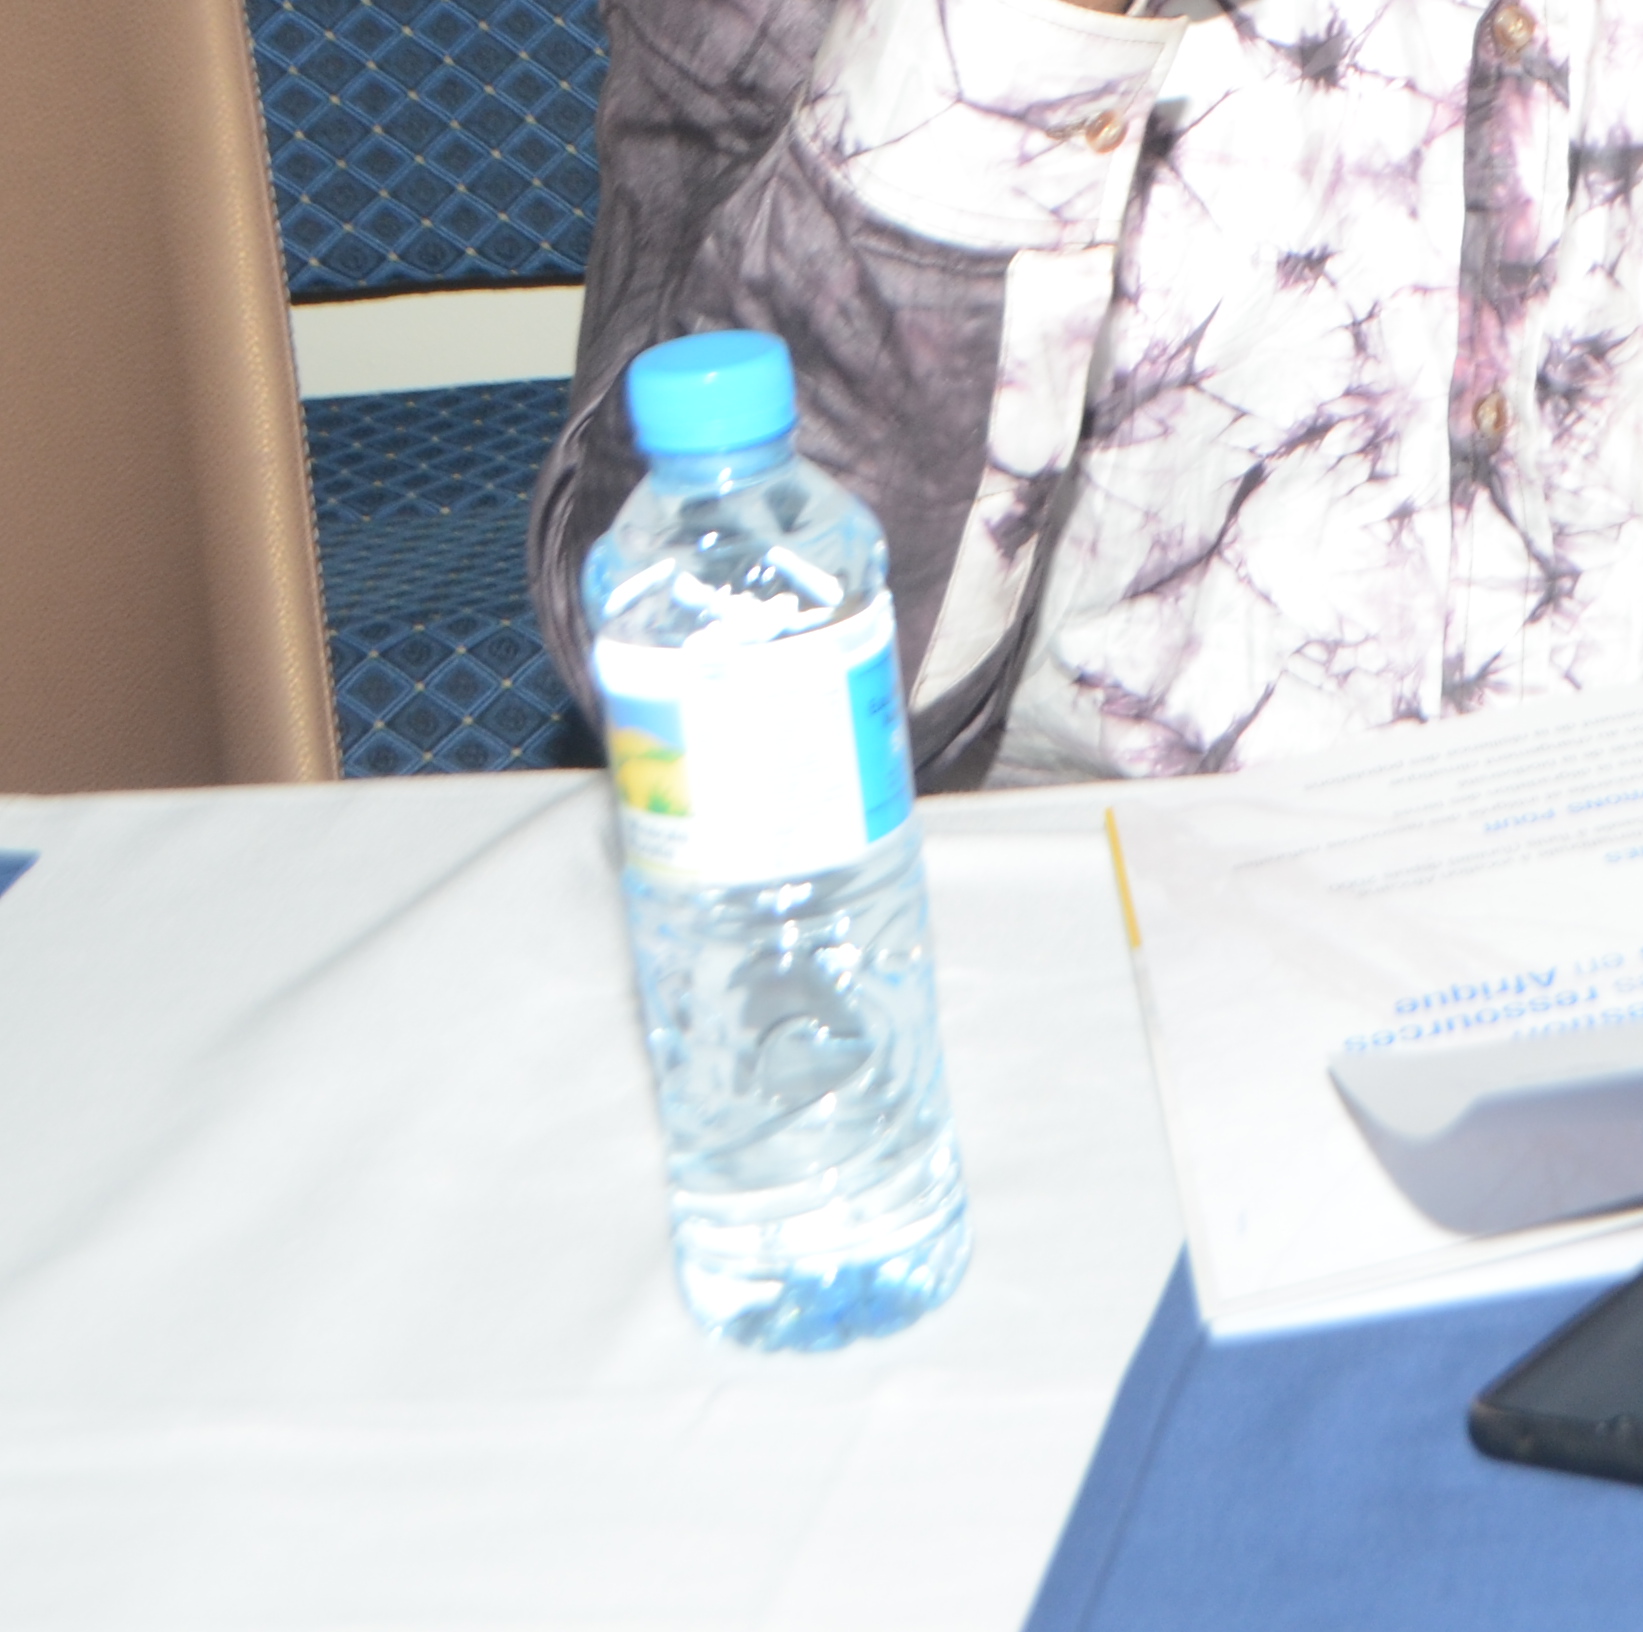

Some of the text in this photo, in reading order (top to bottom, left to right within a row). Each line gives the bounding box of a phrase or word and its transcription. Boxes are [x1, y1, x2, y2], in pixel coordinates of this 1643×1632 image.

[1393, 963, 1556, 1018] Afrique
[1575, 951, 1624, 975] en
[1343, 984, 1598, 1053] ressources
